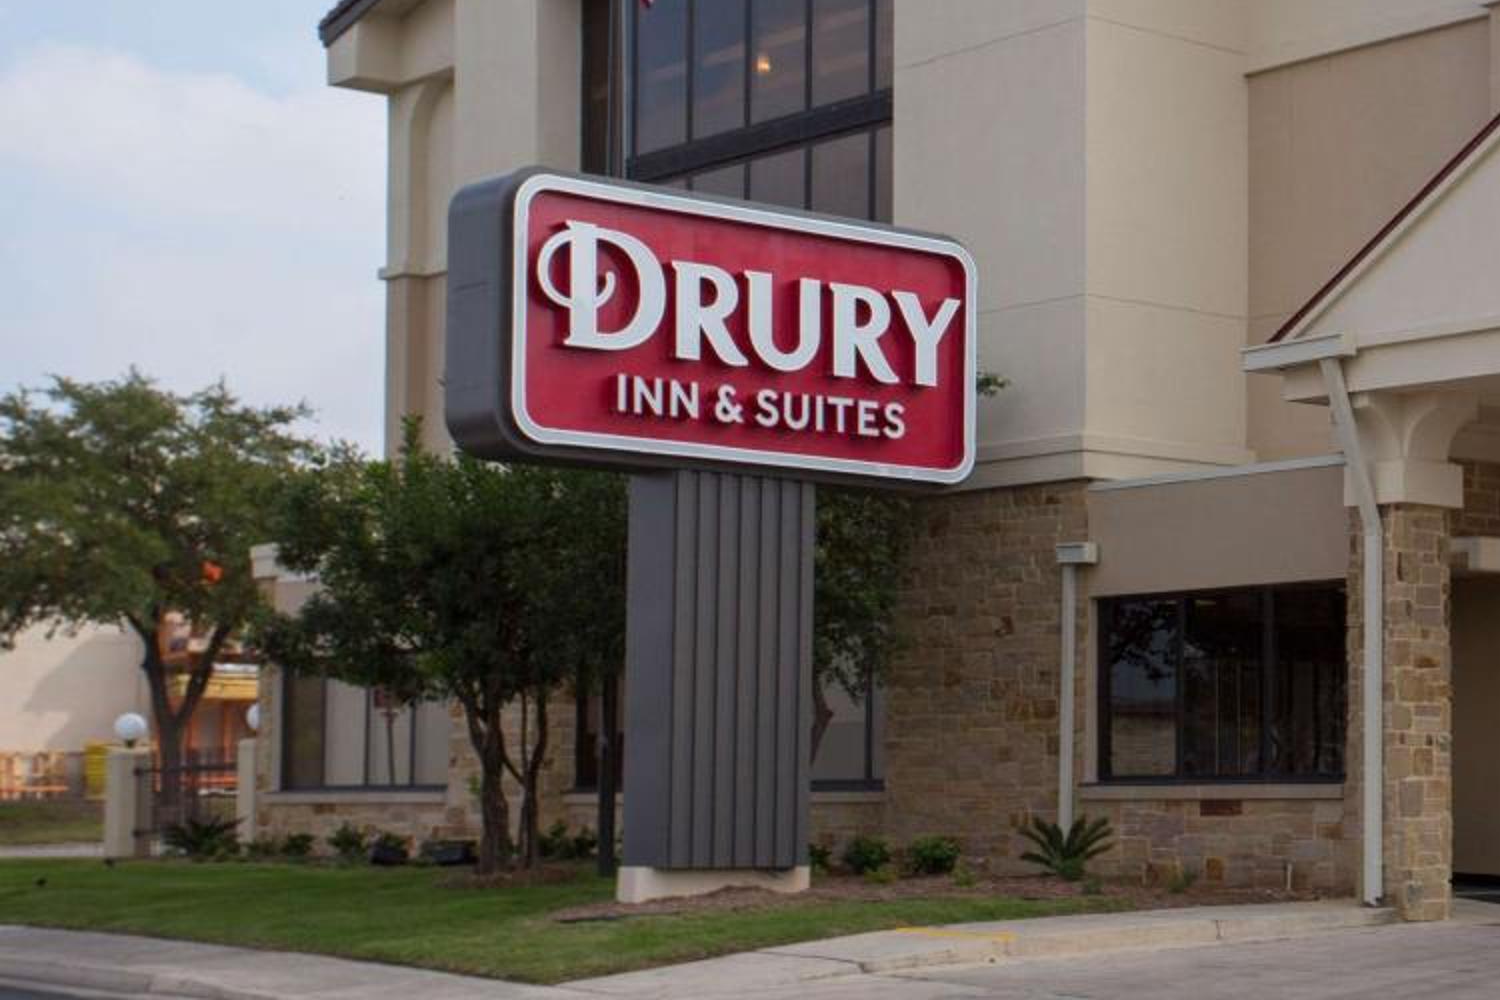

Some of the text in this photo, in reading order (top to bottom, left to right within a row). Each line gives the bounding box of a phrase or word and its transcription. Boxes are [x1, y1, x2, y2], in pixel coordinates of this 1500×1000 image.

[537, 219, 961, 387] DRURY
[617, 373, 906, 440] INN & SUITES
